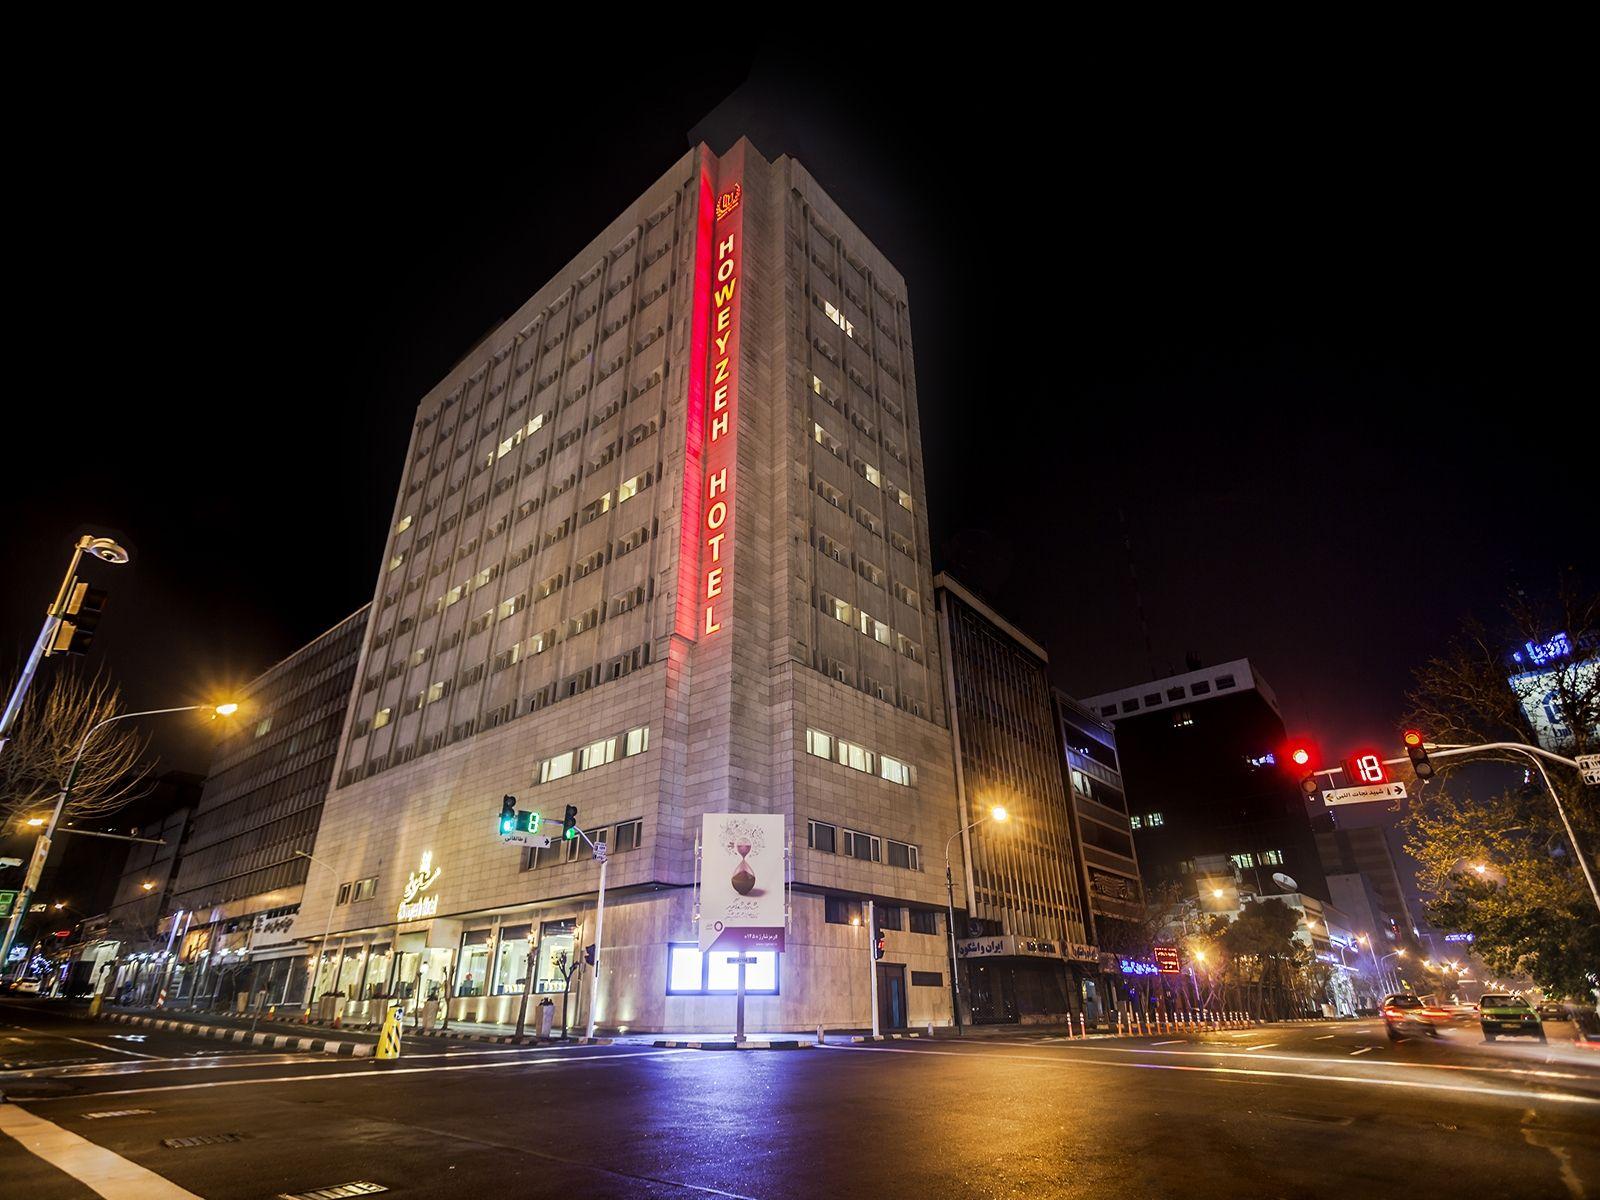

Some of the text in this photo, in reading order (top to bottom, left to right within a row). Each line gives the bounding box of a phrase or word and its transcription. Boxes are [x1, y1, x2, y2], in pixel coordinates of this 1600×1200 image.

[705, 233, 737, 635] HOWEYZEH HOTEL
[1356, 755, 1383, 782] 18
[1352, 790, 1368, 798] نجات
[1368, 788, 1384, 797] شهید
[528, 812, 540, 834] 8
[985, 940, 1004, 954] ایران
